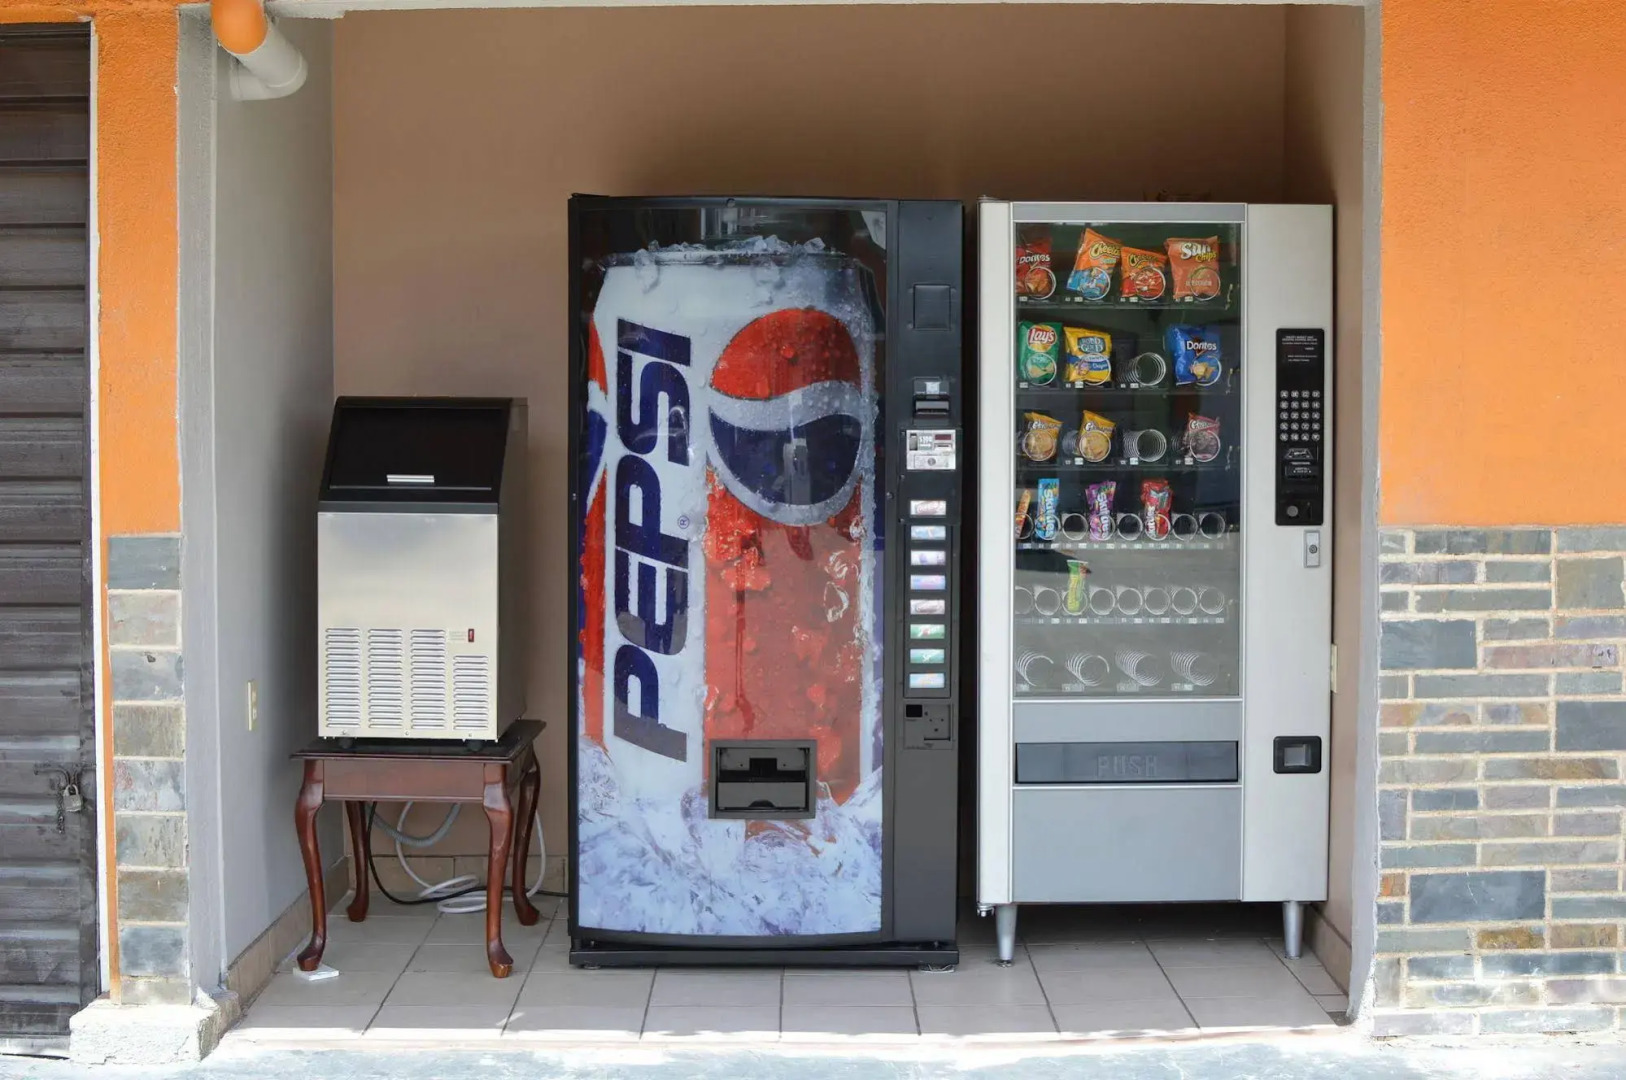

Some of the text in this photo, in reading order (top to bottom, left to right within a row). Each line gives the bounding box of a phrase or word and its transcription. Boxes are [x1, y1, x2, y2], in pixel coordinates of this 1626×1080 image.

[1180, 242, 1211, 260] Sun
[1028, 328, 1056, 344] Lay's
[1186, 341, 1218, 352] Doritos
[613, 318, 692, 763] PEPSI
[1097, 755, 1158, 777] PUSH
